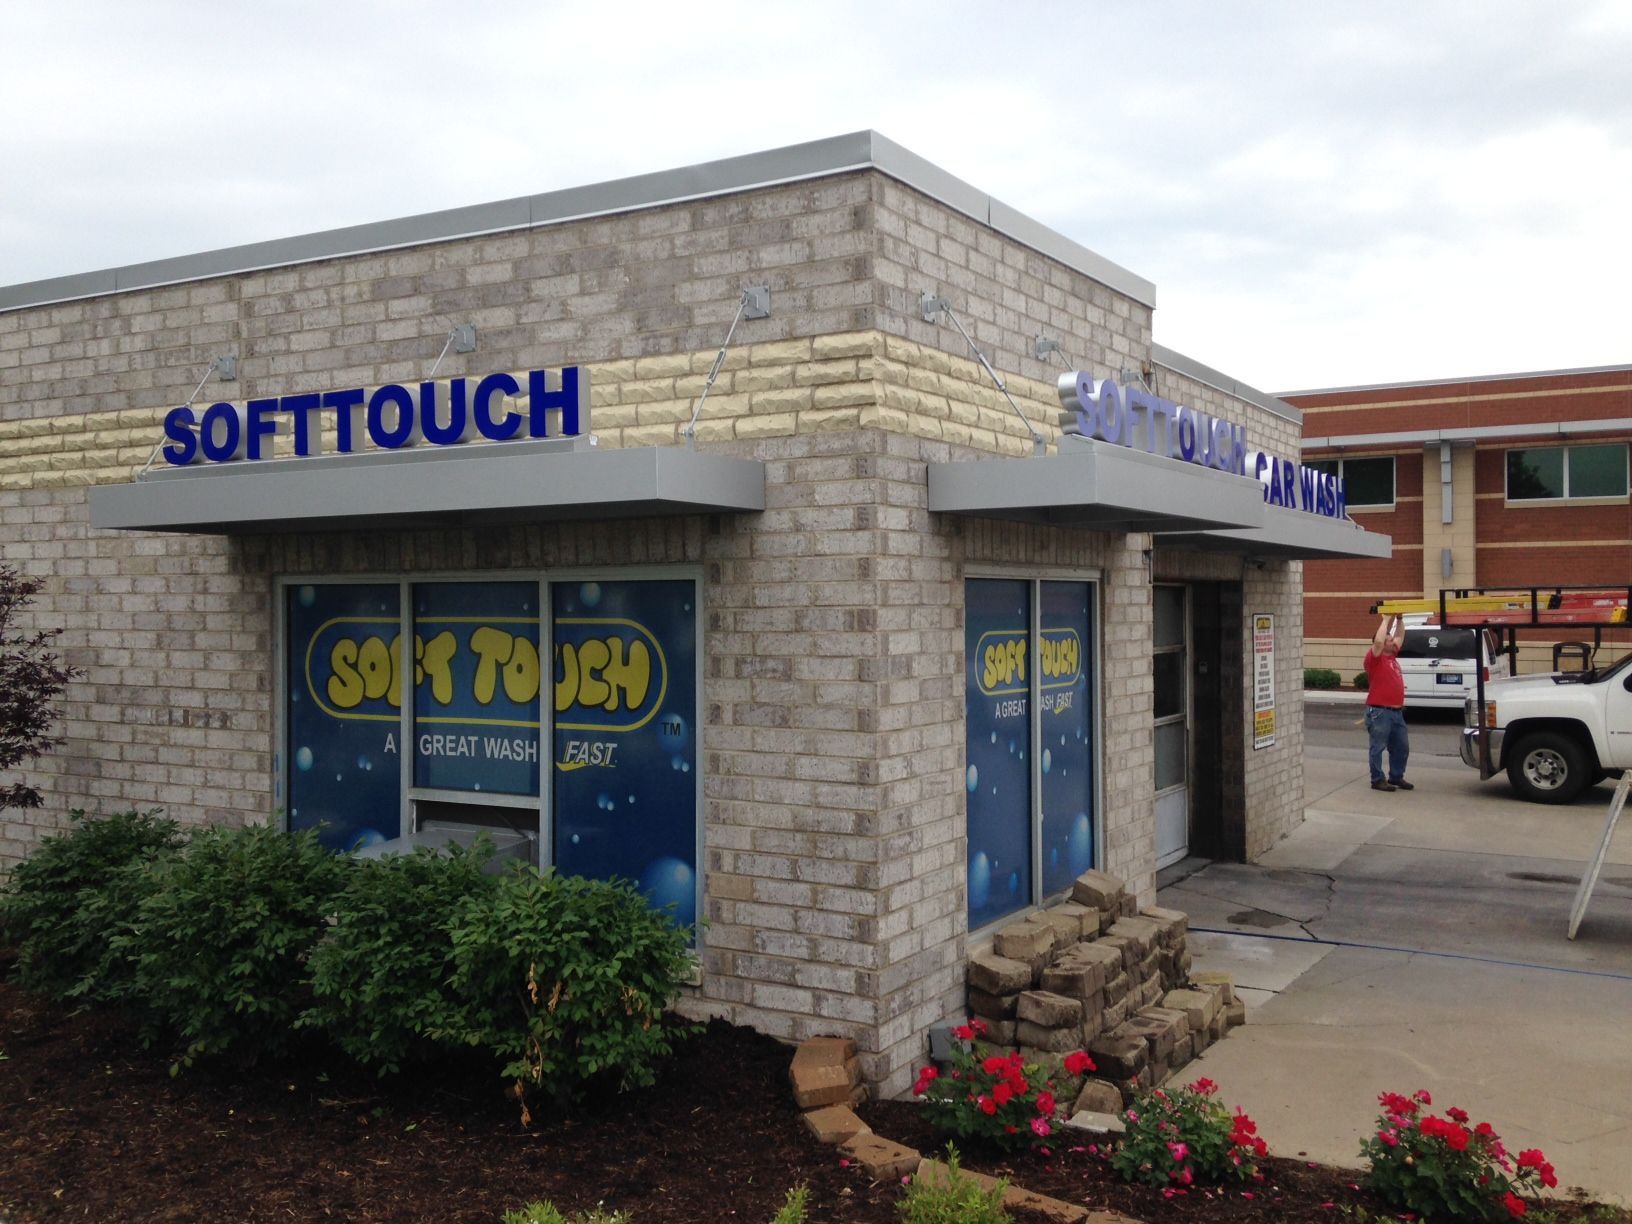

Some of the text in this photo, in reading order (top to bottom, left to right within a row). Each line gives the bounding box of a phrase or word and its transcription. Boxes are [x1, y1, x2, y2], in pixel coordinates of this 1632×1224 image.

[1254, 451, 1297, 509] CAR
[1299, 464, 1346, 520] WASH
[469, 625, 652, 712] TOUCH
[661, 722, 681, 736] TM
[982, 638, 1027, 689] SOFT
[995, 691, 1074, 719] A GREAT ASH FAST
[383, 732, 618, 766] A GREAT WASH FAST
